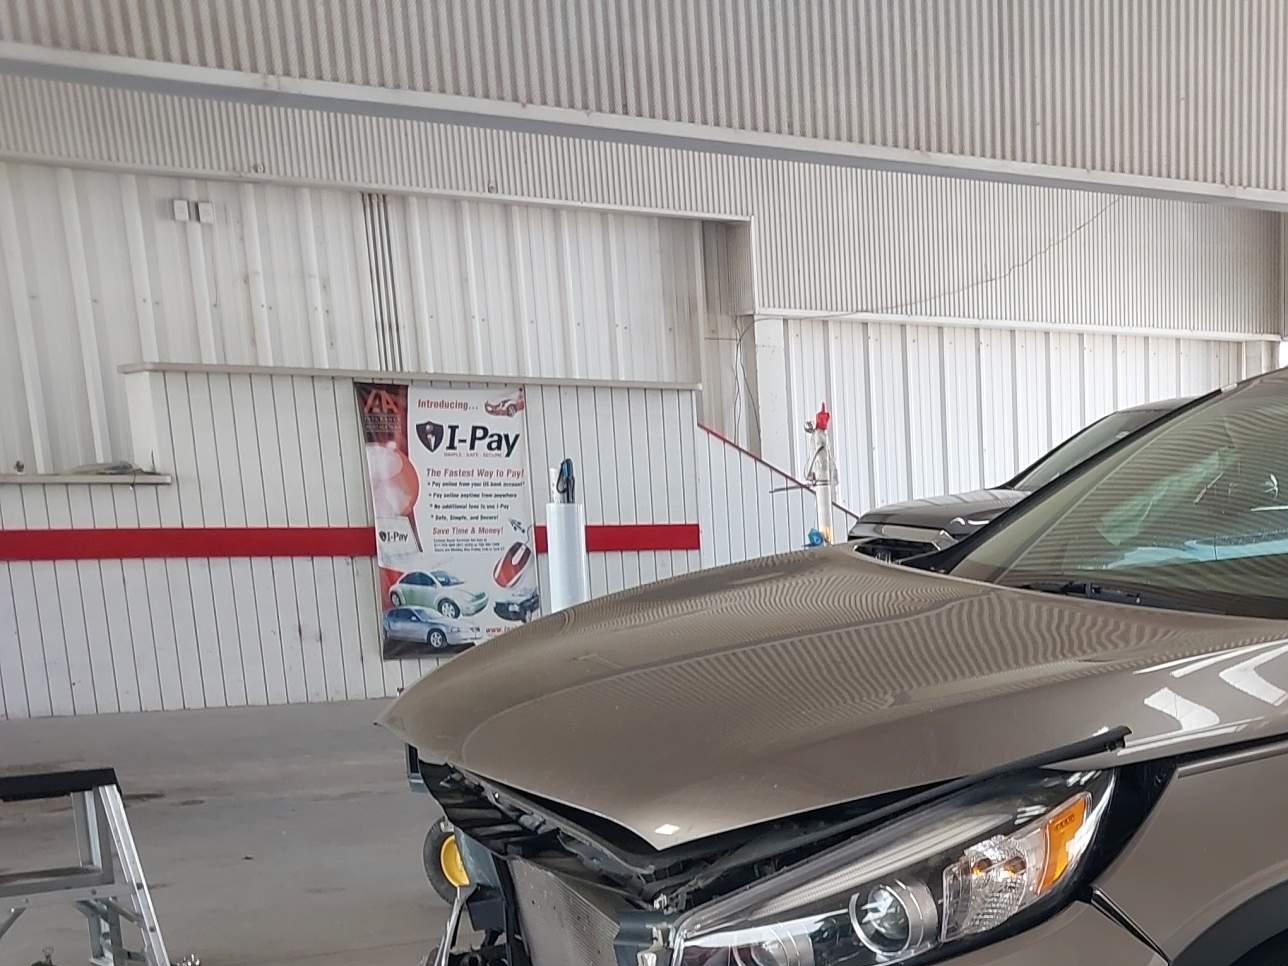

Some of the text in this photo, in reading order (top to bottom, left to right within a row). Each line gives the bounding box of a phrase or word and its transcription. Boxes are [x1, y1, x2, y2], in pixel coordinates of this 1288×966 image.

[417, 400, 479, 412] Introducing...
[445, 425, 520, 457] I-Pay
[427, 468, 524, 479] The Fastest Way to Pay!
[432, 527, 450, 535] Save
[452, 527, 469, 535] Time
[478, 527, 503, 536] Money!
